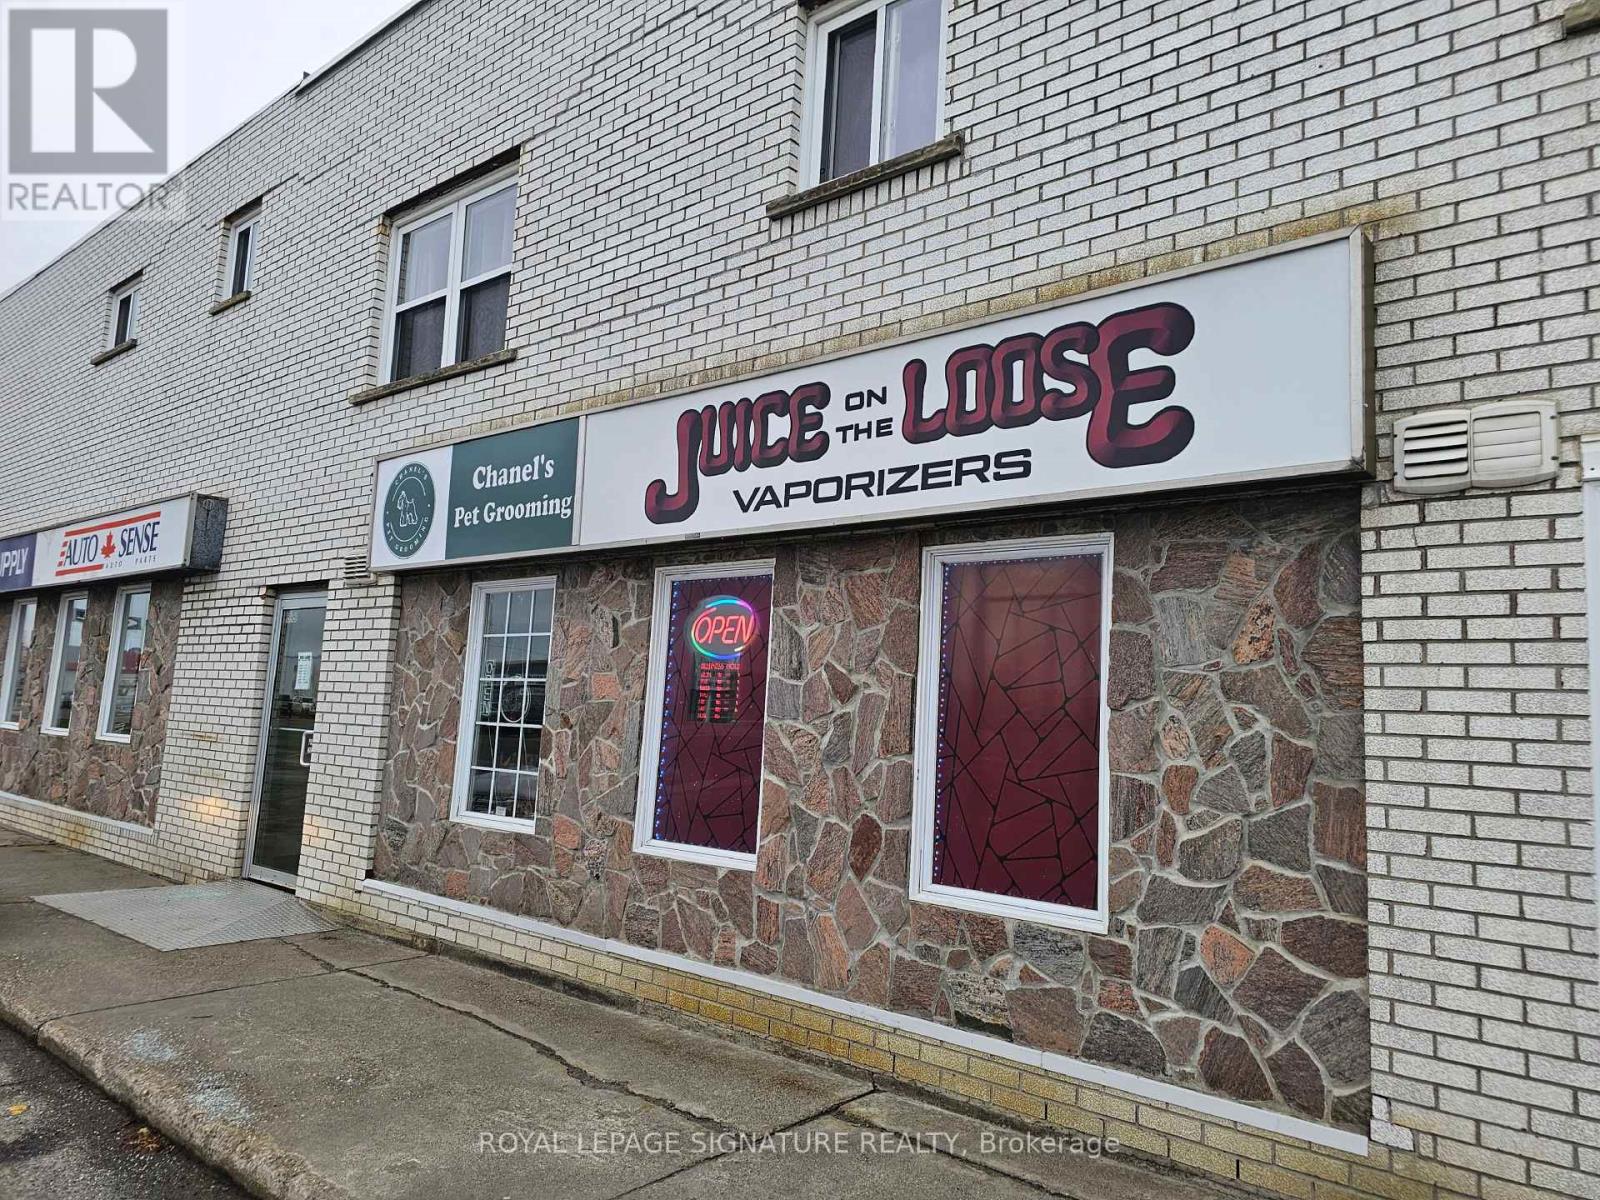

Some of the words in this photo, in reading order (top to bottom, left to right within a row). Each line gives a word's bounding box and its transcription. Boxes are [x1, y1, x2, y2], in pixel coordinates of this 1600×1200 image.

[645, 381, 831, 524] JUICE
[844, 386, 889, 411] ON
[902, 302, 1195, 467] LOOSE
[836, 417, 893, 444] THE
[472, 454, 555, 490] Chanel's
[733, 448, 1032, 513] VAPORIZERS
[453, 505, 480, 528] Pet
[484, 494, 572, 523] Grooming
[0, 547, 29, 577] PPLY
[62, 534, 99, 566] AUTO
[118, 521, 160, 558] SENSE
[694, 606, 755, 645] OPEN
